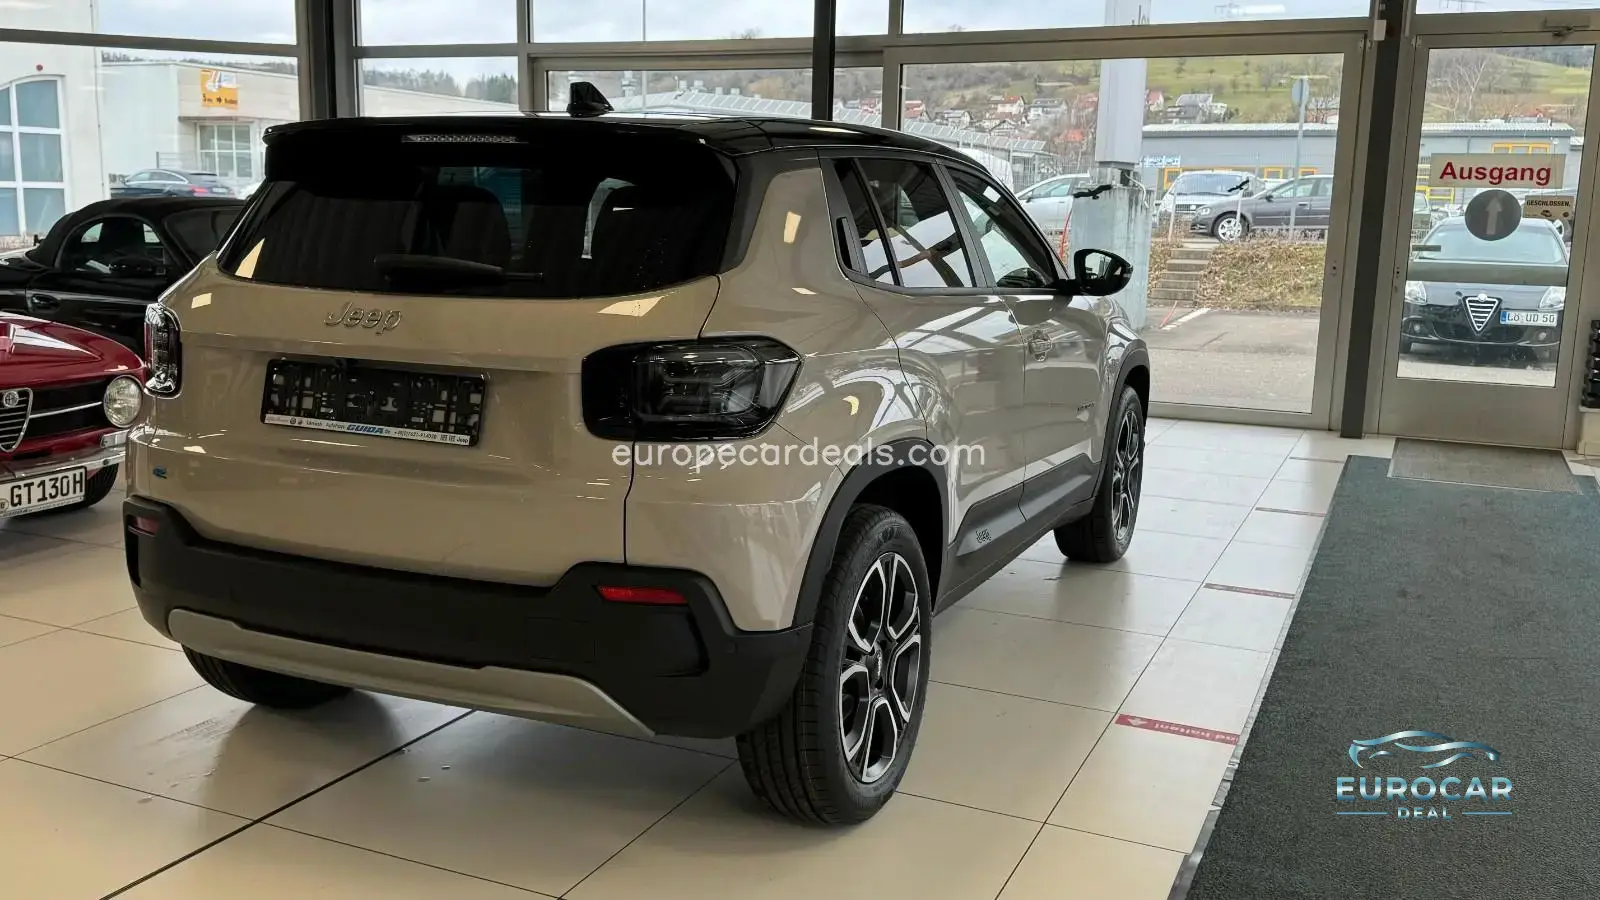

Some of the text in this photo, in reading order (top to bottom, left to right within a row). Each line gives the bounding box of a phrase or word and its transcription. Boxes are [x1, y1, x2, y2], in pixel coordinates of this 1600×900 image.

[1440, 161, 1551, 186] Ausgang
[323, 301, 402, 336] Jeep
[1507, 312, 1520, 322] LÖ
[1542, 314, 1555, 323] 50
[347, 424, 384, 434] GUIDA
